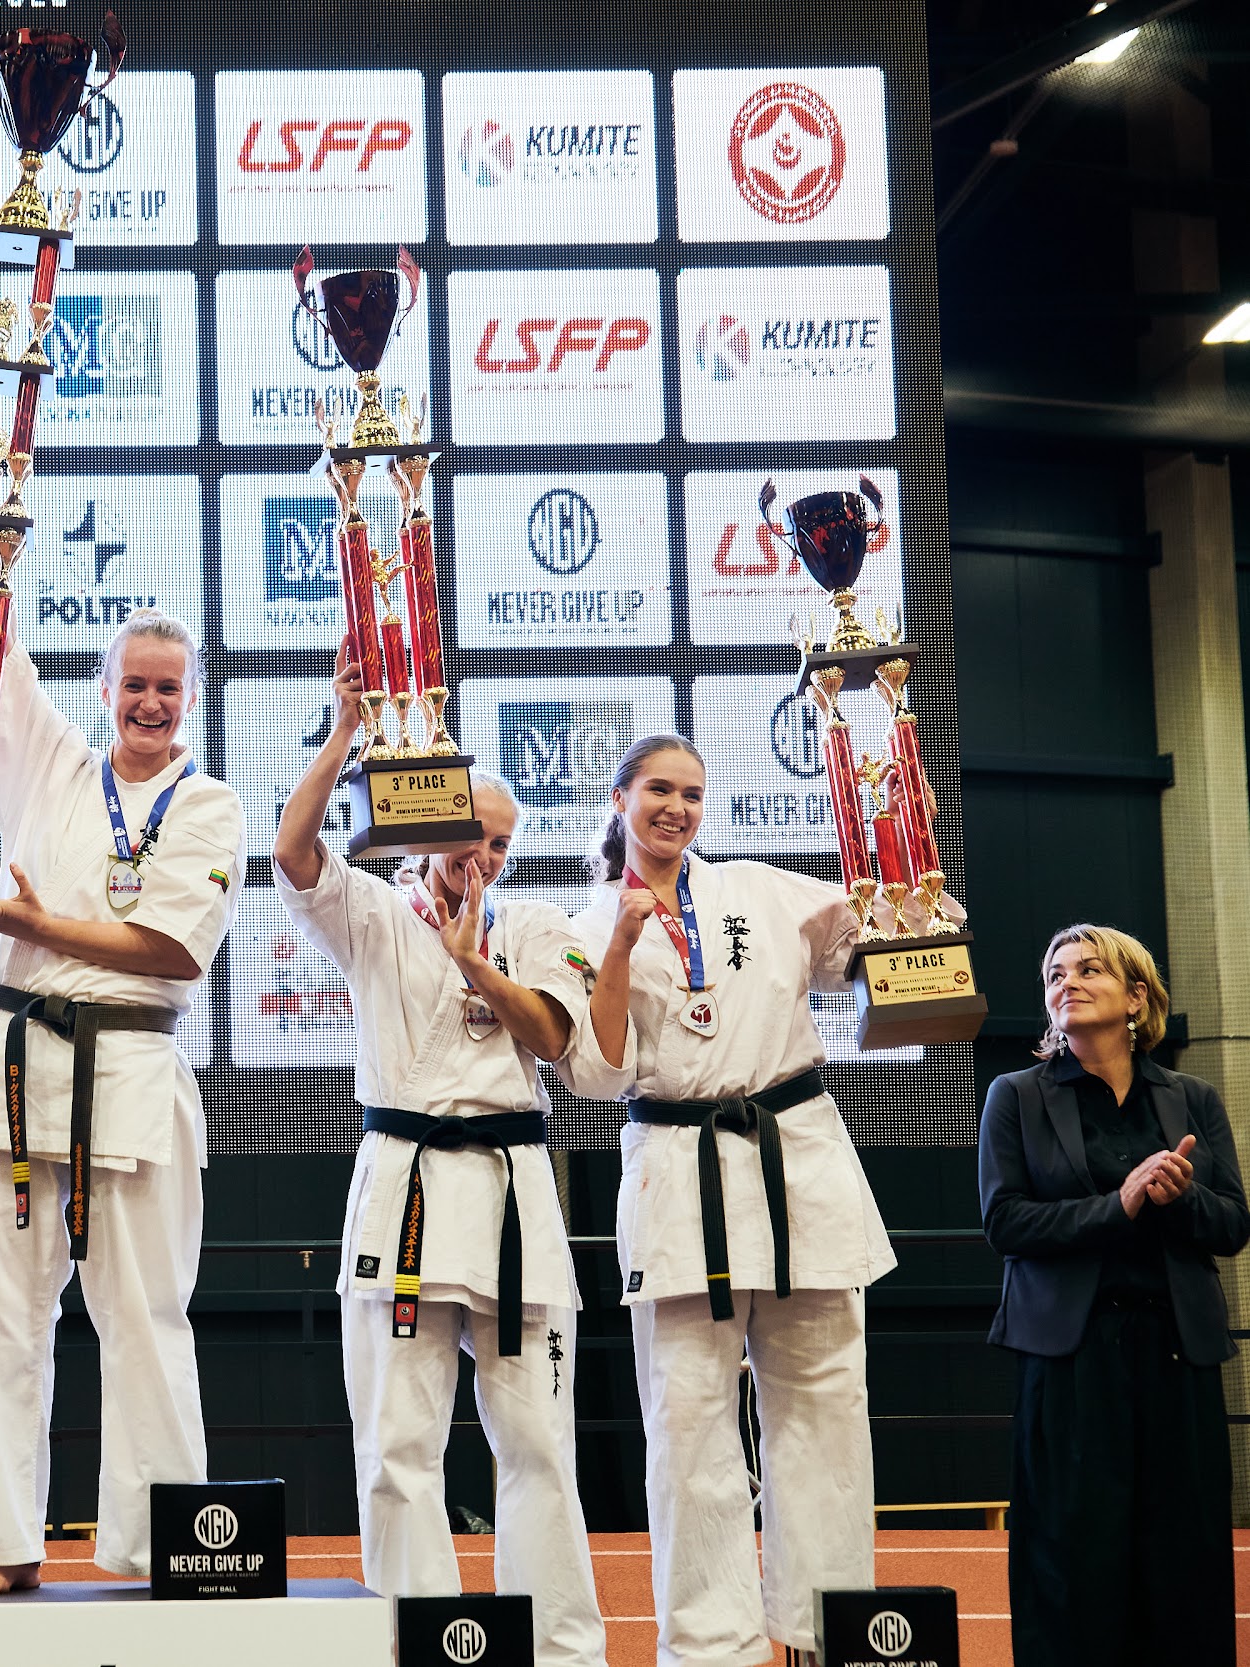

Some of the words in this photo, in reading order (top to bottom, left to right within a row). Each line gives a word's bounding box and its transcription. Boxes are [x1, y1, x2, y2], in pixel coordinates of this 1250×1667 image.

[237, 120, 413, 172] LSFP
[525, 124, 642, 157] KUMITE
[141, 190, 166, 220] UP
[474, 317, 652, 373] LSFP
[762, 319, 881, 350] KUMITE
[252, 387, 316, 417] NEVER
[325, 385, 362, 416] GIV
[488, 591, 556, 624] NEVER
[562, 590, 609, 623] GIVE
[615, 589, 644, 622] UP
[408, 774, 447, 791] PLACE
[731, 795, 799, 825] NEVER
[905, 953, 946, 970] PLACE
[195, 1505, 238, 1549] NGU
[170, 1554, 210, 1572] NEVER
[214, 1554, 243, 1572] GIVE
[246, 1553, 264, 1571] UP
[198, 1585, 218, 1593] FIGHT
[219, 1585, 237, 1593] BALL
[443, 1618, 487, 1664] NGU
[868, 1611, 912, 1657] NGU
